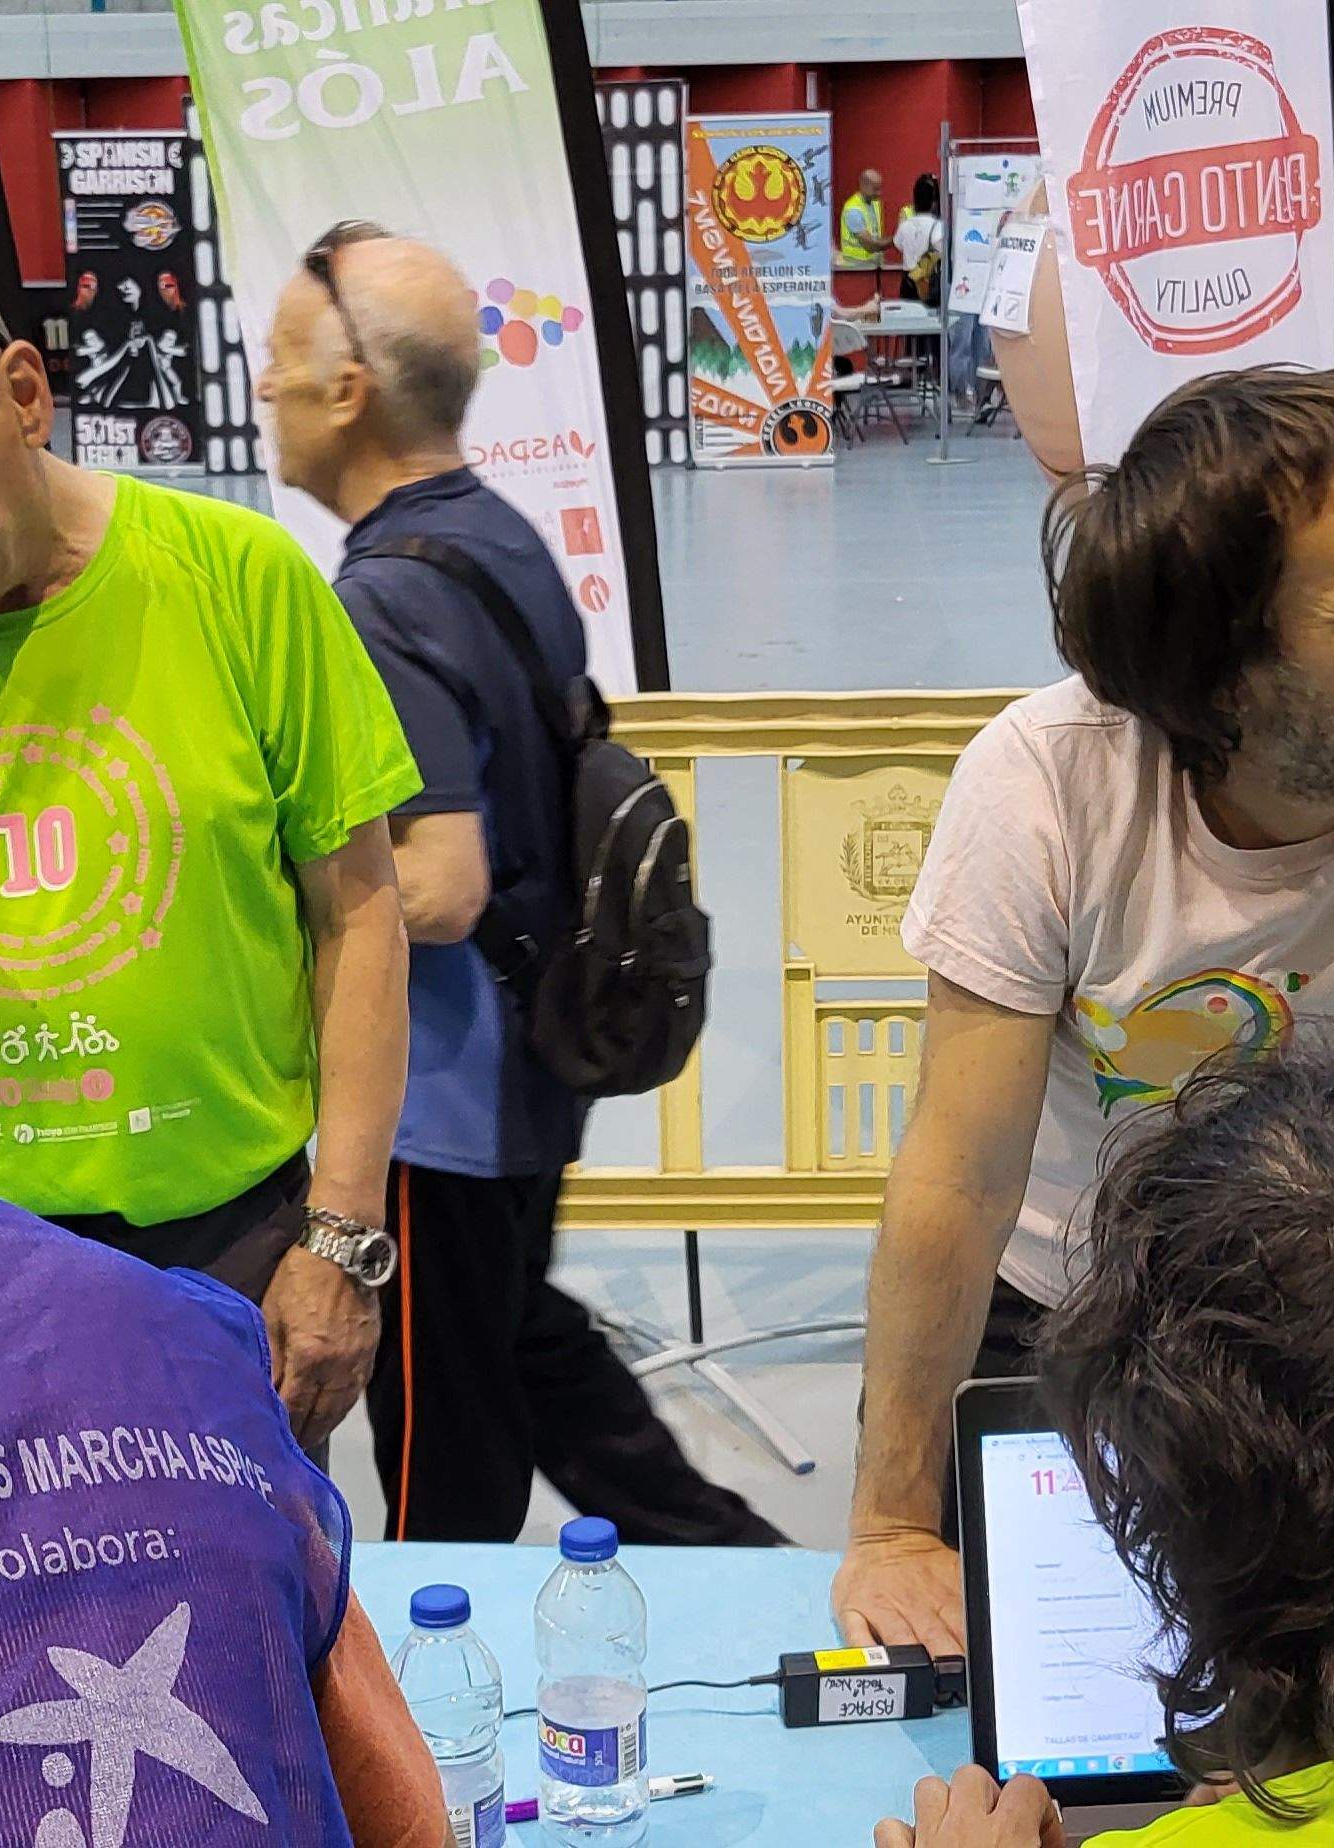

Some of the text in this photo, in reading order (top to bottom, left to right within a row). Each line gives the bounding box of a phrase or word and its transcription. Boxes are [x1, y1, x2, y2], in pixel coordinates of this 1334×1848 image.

[845, 914, 904, 925] AYUNTA
[861, 926, 879, 936] DE
[17, 1425, 194, 1494] MARCHA
[1030, 1469, 1056, 1496] 11
[838, 1700, 895, 1717] ASPACE
